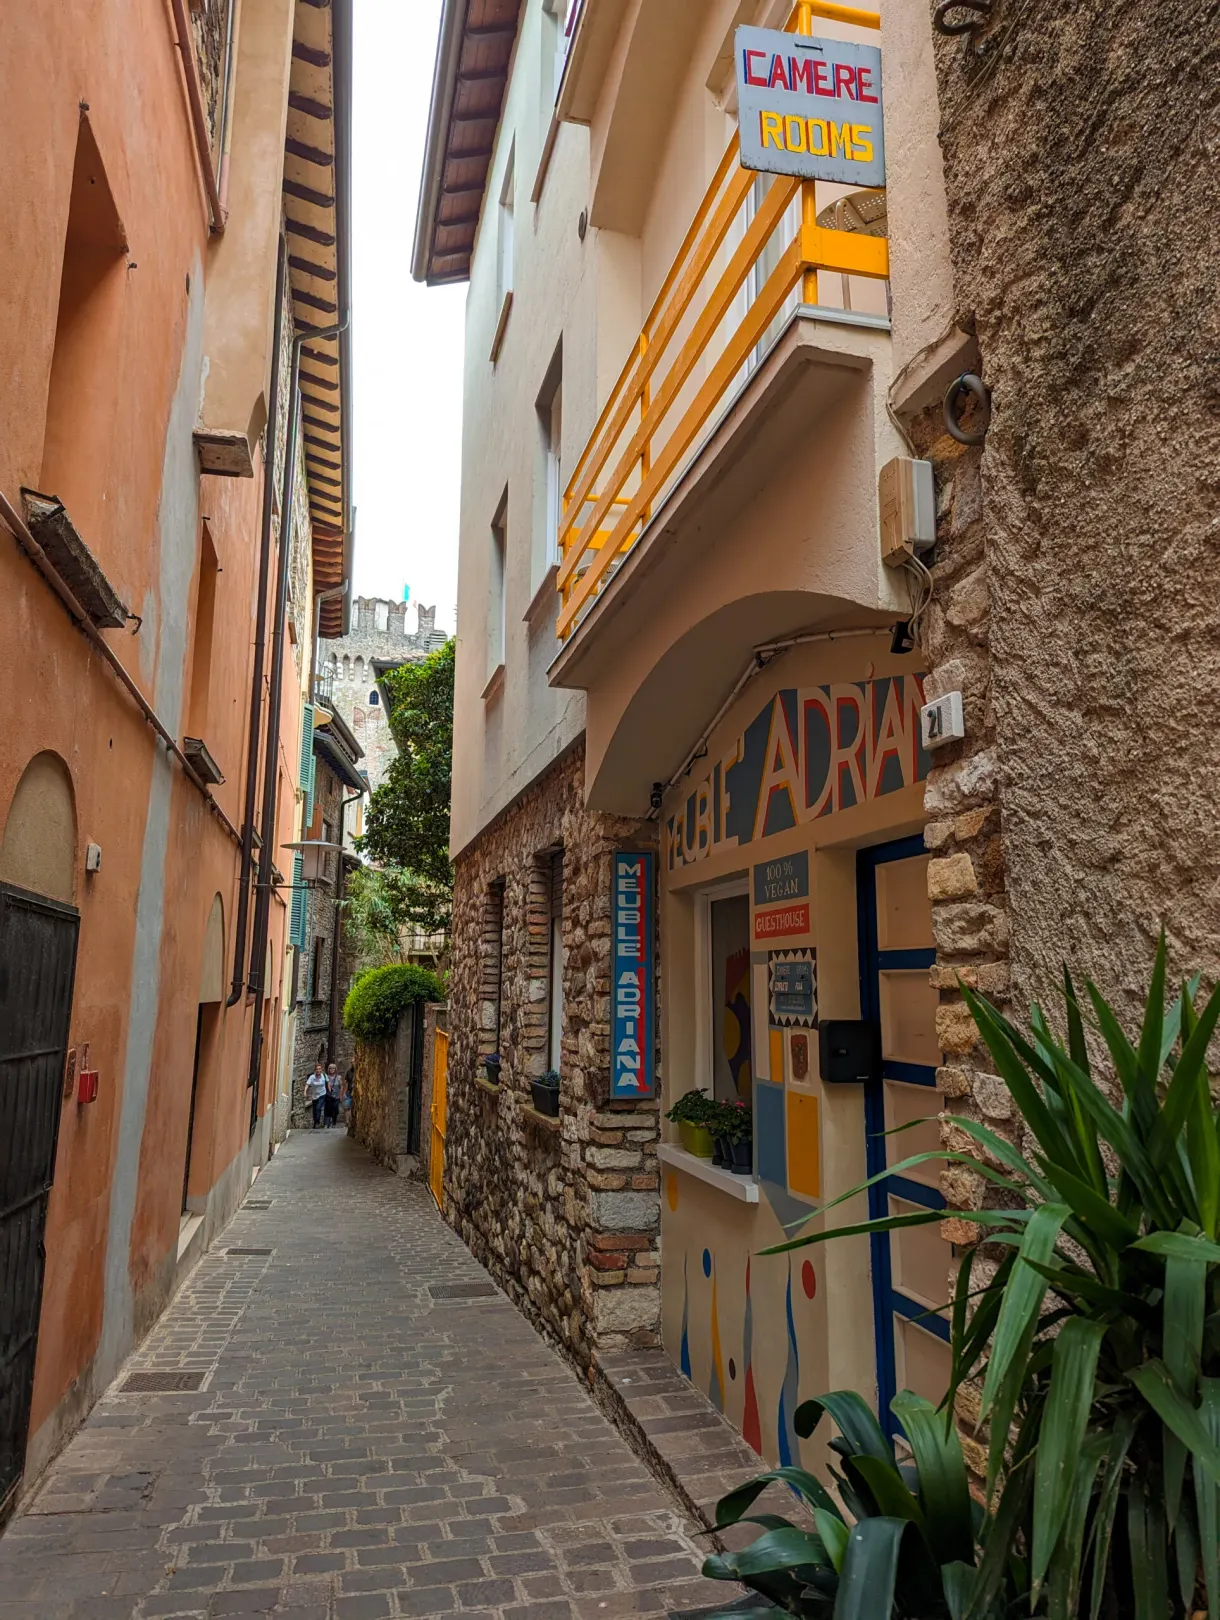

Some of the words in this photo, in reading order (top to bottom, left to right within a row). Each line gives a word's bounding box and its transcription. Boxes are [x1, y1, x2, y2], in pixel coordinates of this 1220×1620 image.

[743, 49, 879, 104] CAMERE
[759, 110, 874, 162] ROOMS
[927, 706, 943, 738] 21
[766, 863, 782, 880] 100
[764, 878, 799, 899] VEGAN
[755, 909, 805, 933] GUESTHOUSE
[617, 971, 642, 1086] ADRIANA
